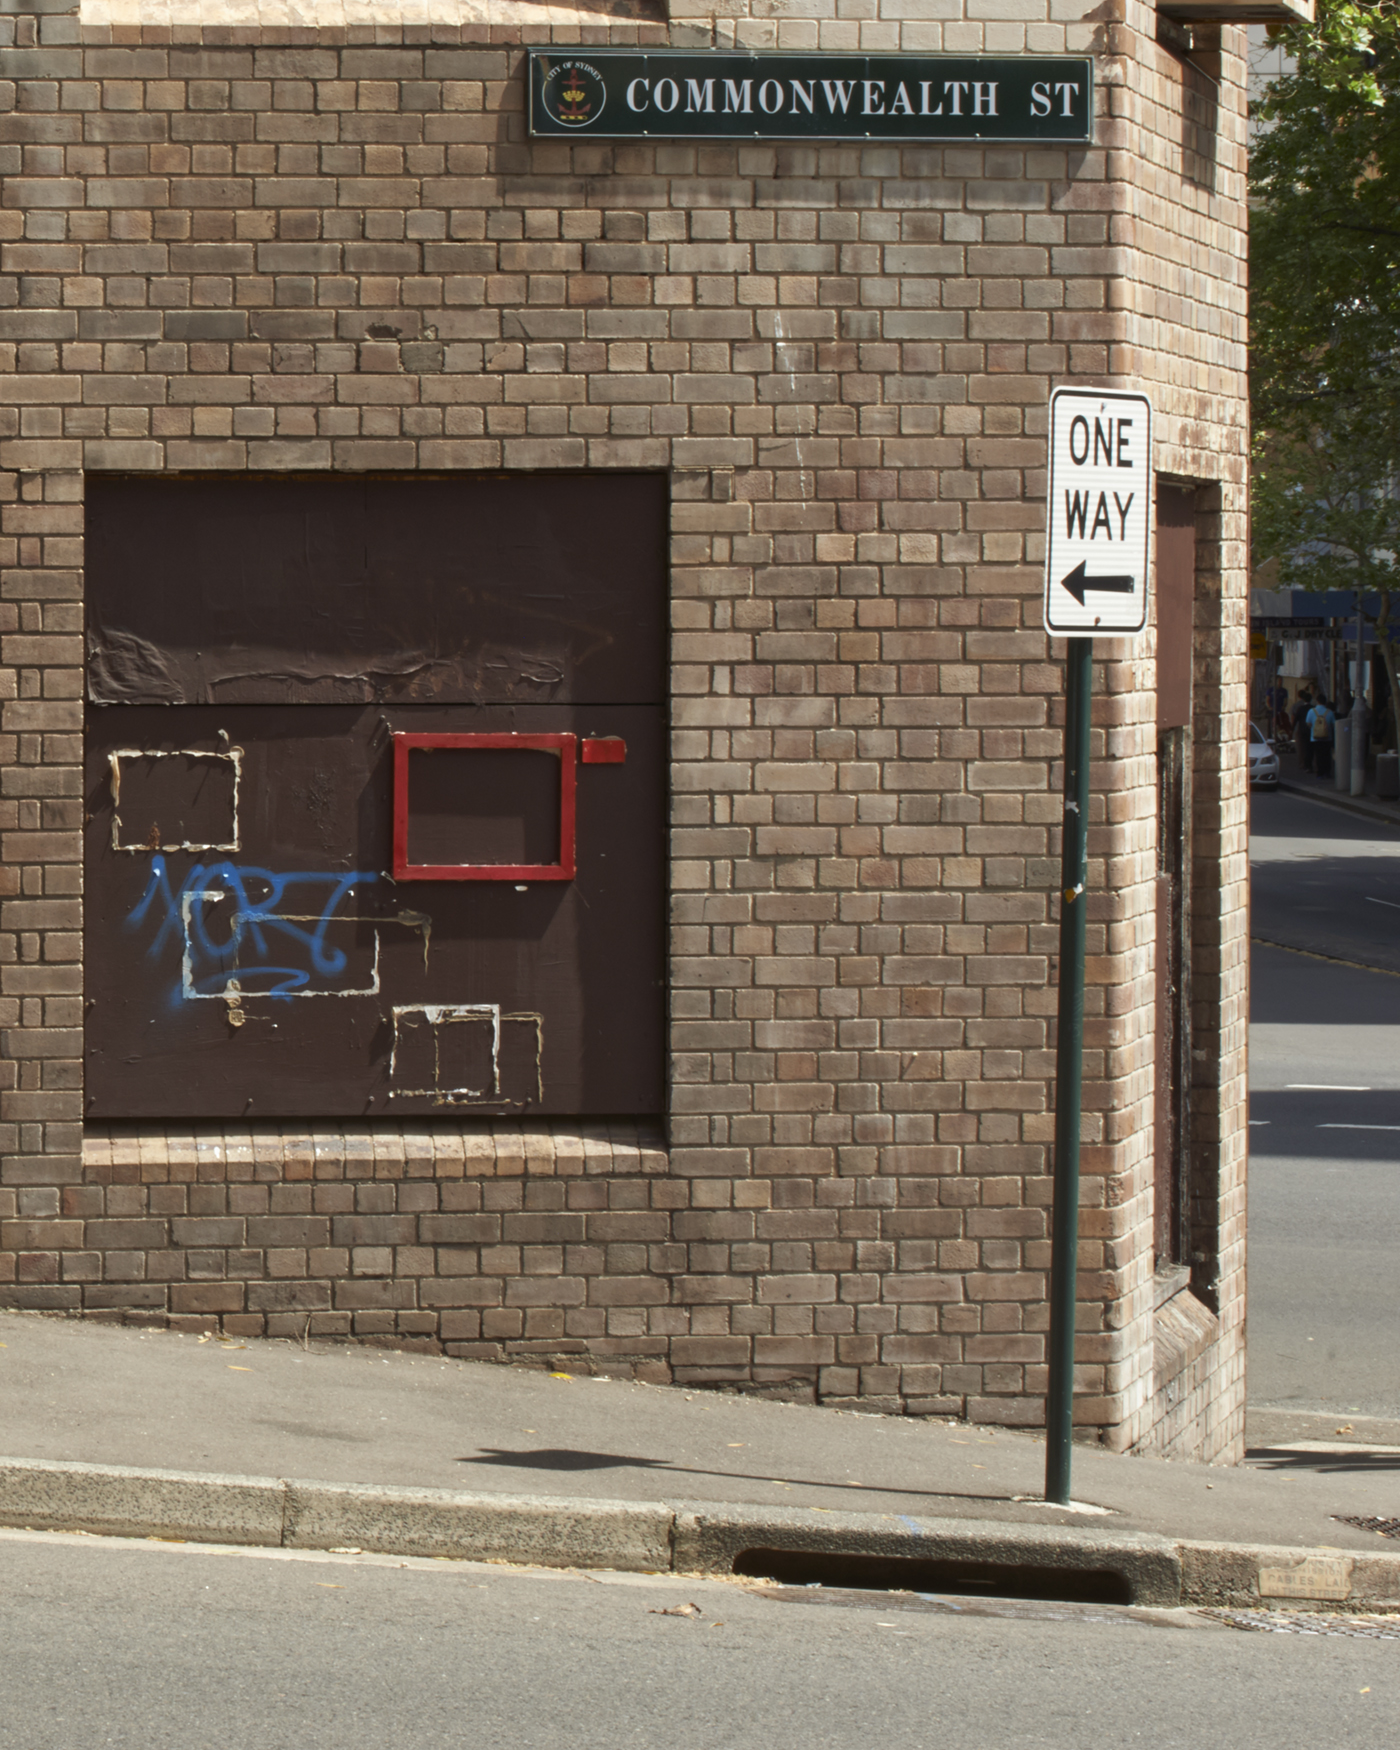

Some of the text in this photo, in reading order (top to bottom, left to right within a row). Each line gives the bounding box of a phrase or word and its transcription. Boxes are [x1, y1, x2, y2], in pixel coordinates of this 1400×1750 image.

[546, 61, 603, 81] CITY OF SYDNEY
[626, 77, 1079, 117] COMMONWEALTH ST
[1069, 415, 1133, 468] ONE
[1065, 489, 1134, 541] WAY
[1282, 1587, 1306, 1597] THIS
